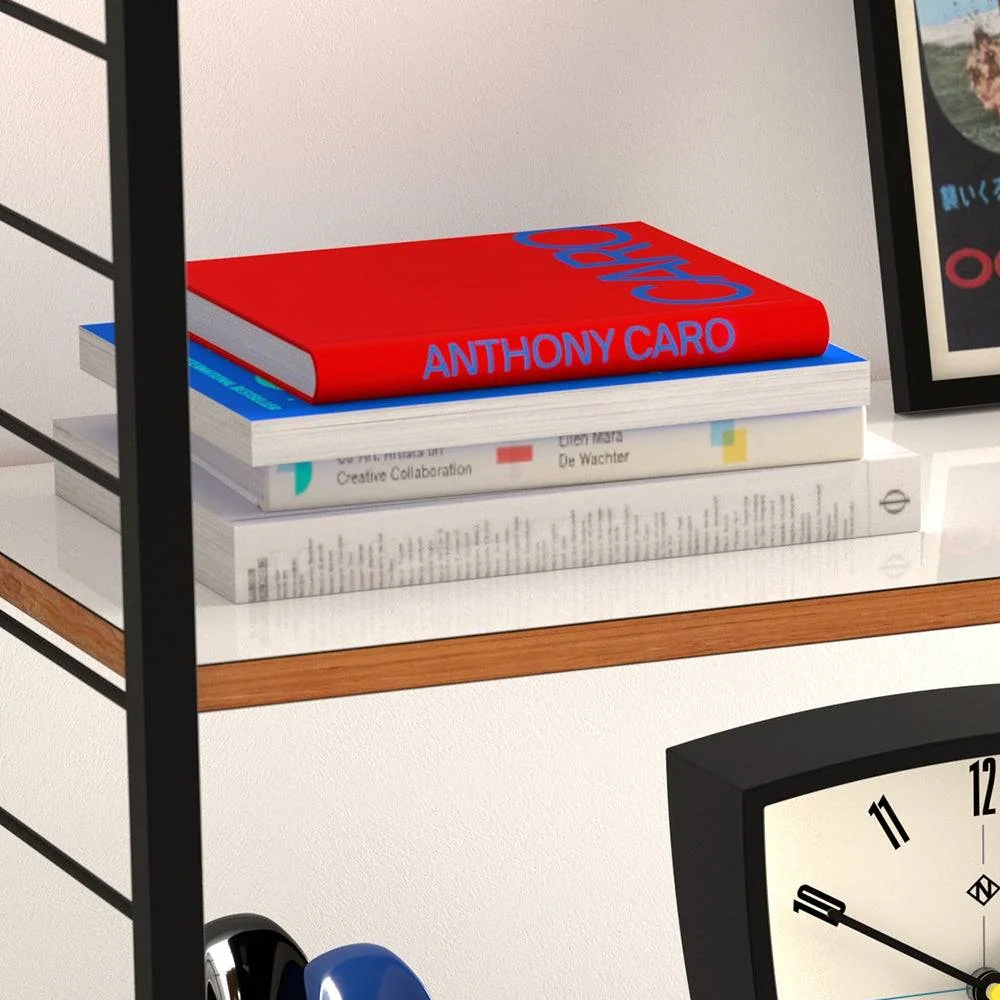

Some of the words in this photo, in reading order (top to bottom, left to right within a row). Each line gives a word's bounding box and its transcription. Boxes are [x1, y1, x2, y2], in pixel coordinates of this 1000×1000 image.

[512, 225, 754, 305] CARO
[422, 327, 616, 381] ANTHONY
[623, 317, 736, 362] CARO
[336, 468, 388, 486] Creative
[390, 462, 473, 482] Collaboration
[558, 452, 576, 469] De
[579, 450, 630, 467] Wachter
[969, 757, 997, 817] 12
[867, 794, 911, 851] 11
[792, 884, 847, 927] 10
